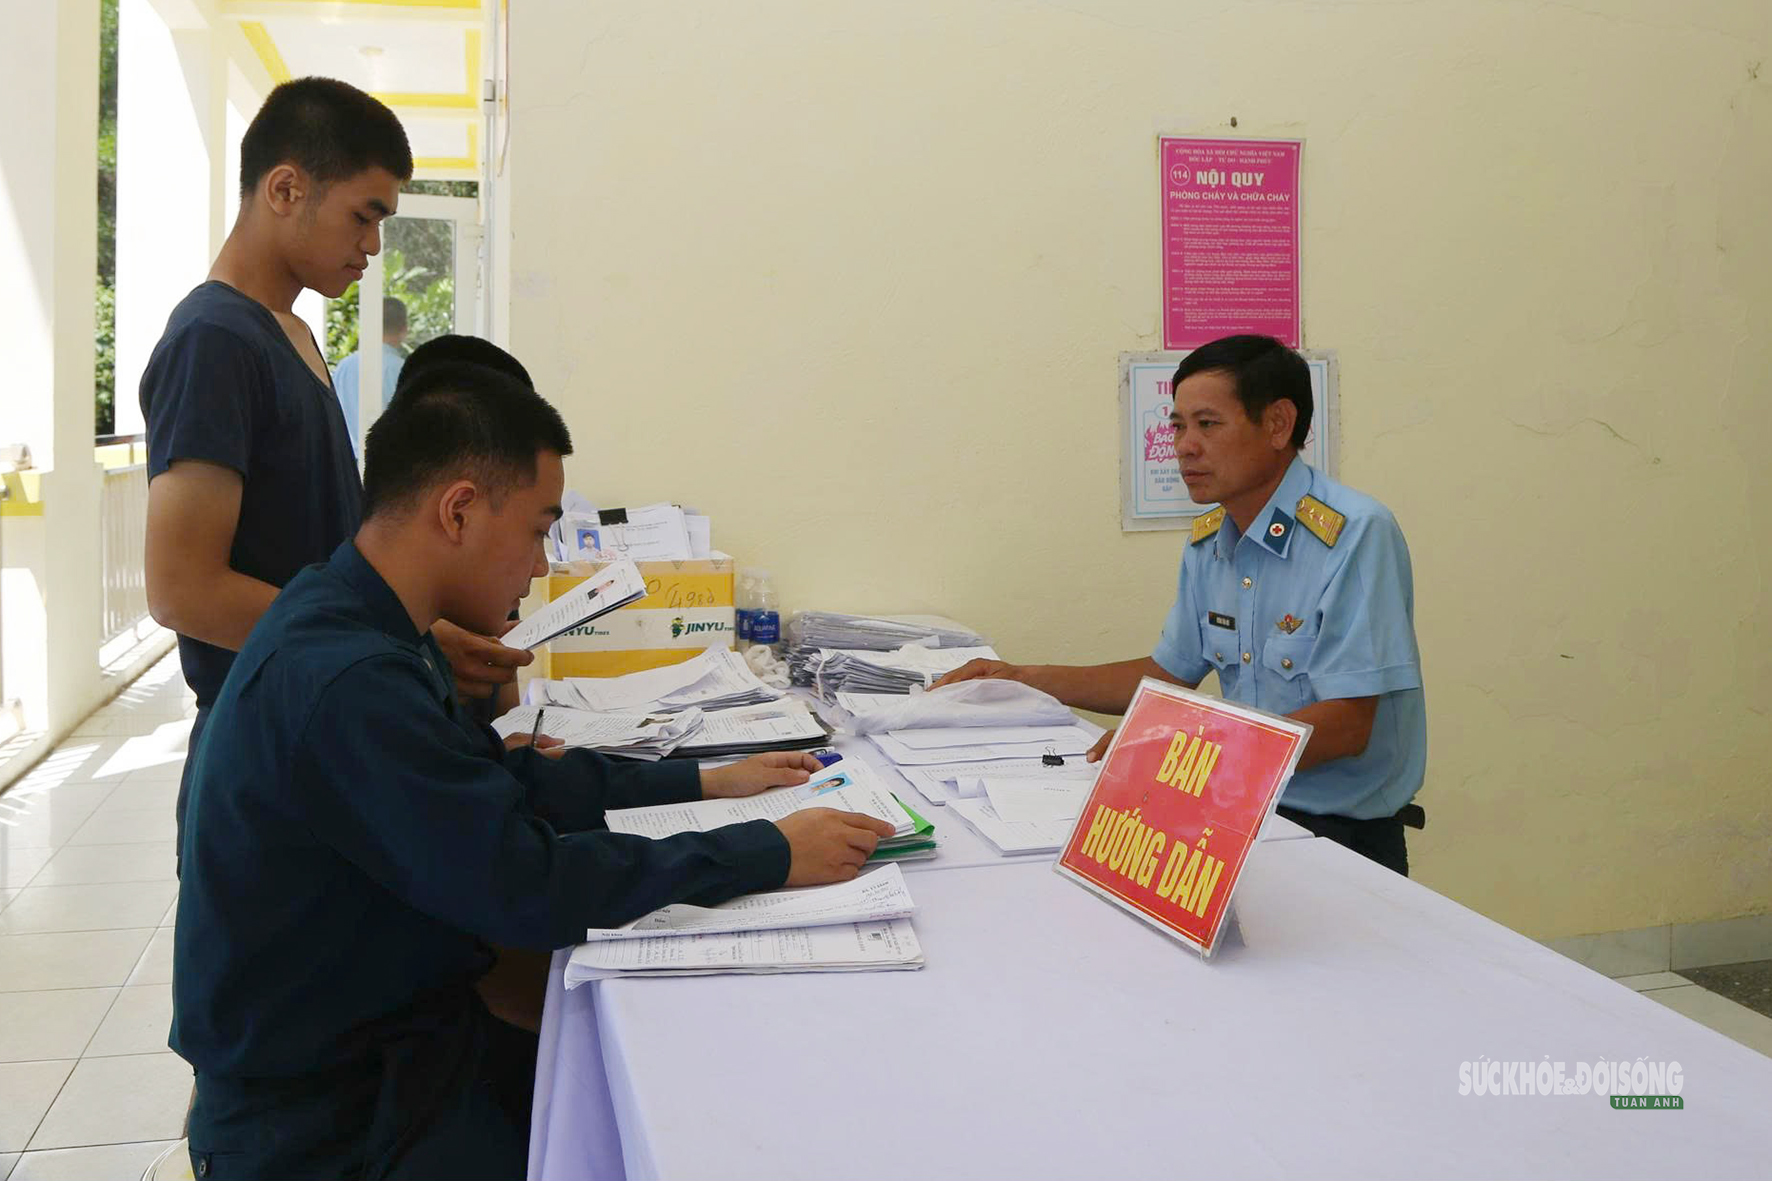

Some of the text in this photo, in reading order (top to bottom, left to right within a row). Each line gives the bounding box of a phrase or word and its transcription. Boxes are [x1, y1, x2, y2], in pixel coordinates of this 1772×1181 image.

[1172, 171, 1188, 179] 114
[1196, 168, 1264, 188] NỘI QUY
[1170, 190, 1290, 202] PHÒNG CHÁY VÀ CHỮA CHÁY
[1162, 405, 1168, 416] 1
[685, 622, 725, 635] JINYU
[1081, 804, 1225, 918] HƯỚNG DẪN
